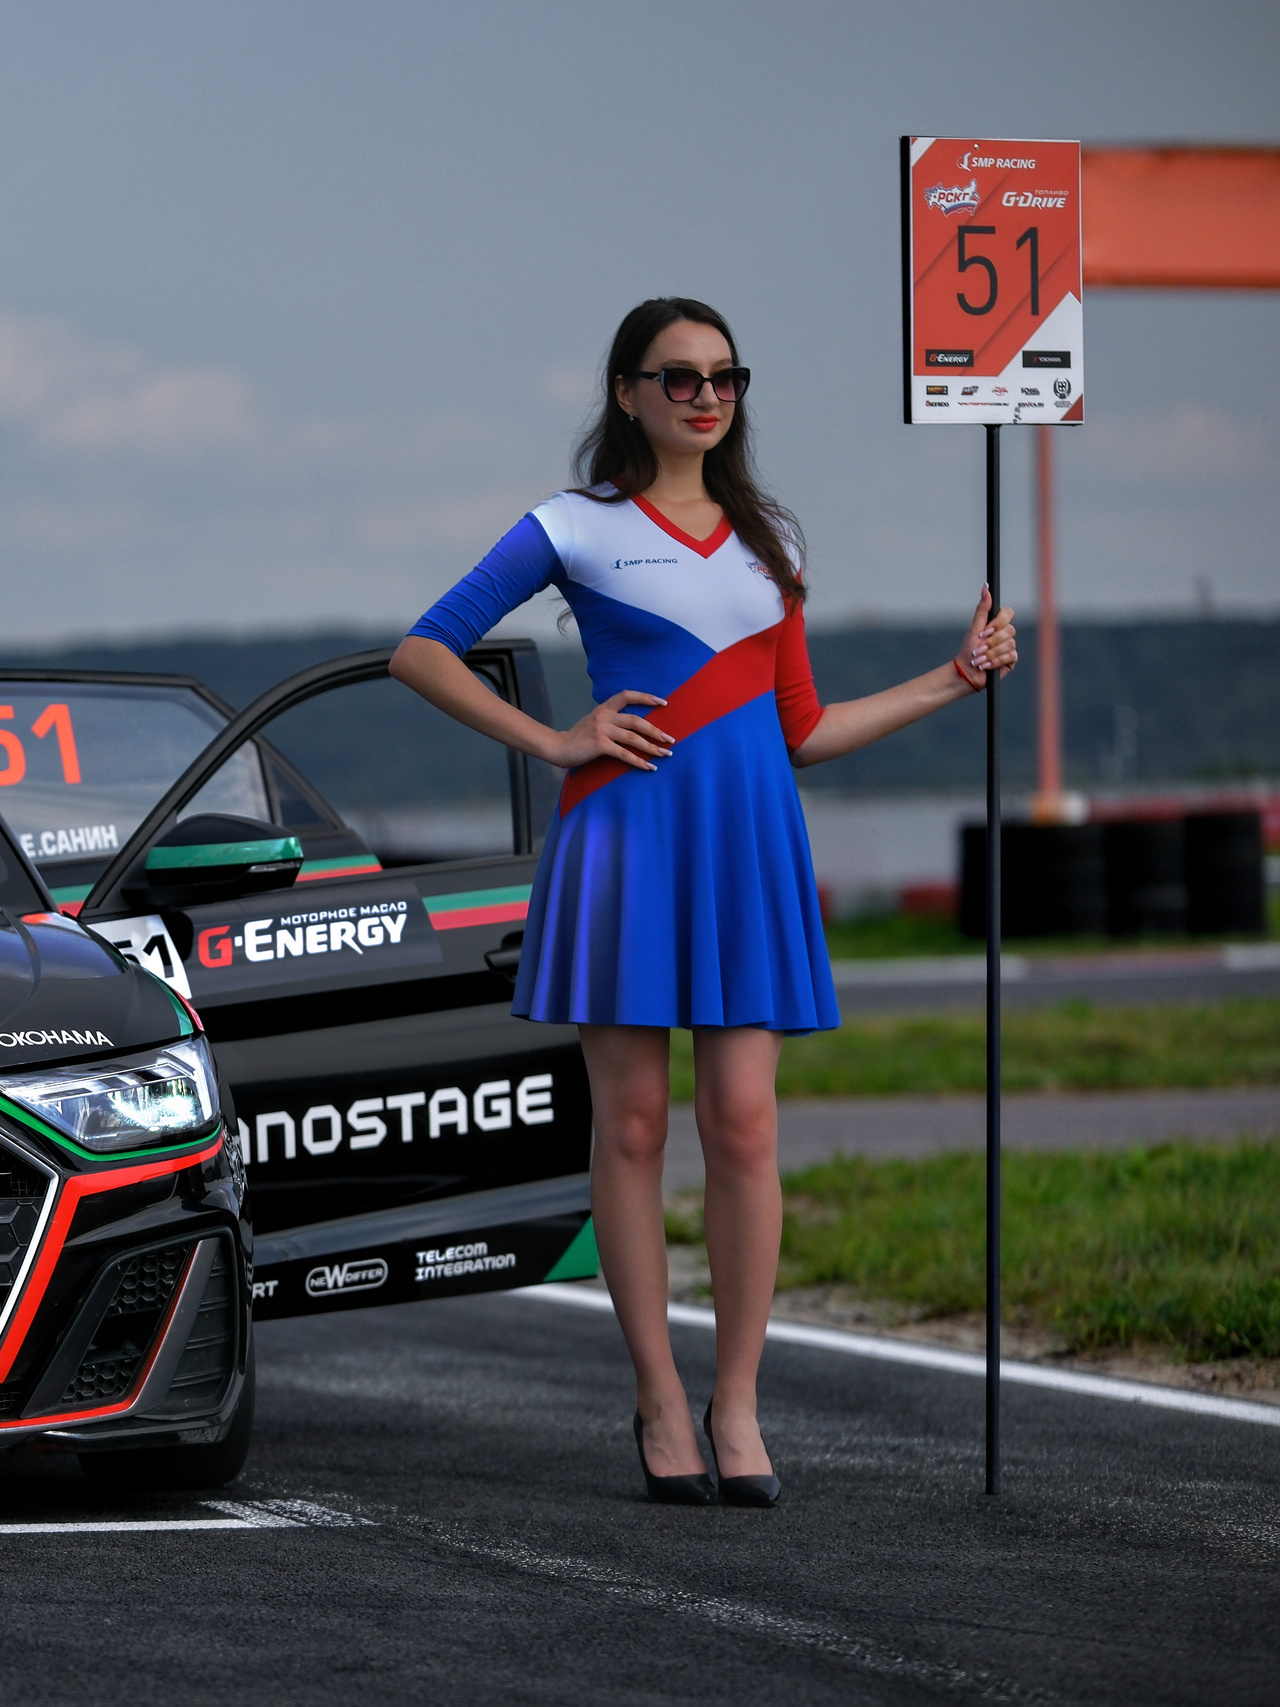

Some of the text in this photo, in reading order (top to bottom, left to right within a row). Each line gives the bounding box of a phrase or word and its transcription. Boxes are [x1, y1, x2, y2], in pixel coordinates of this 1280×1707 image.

[971, 157, 1036, 169] SMP RACING
[956, 225, 1040, 316] 51
[623, 559, 643, 567] SMP
[280, 901, 408, 926] МОТОРНОЕ МАСЛО
[416, 1241, 488, 1265] TELECOM
[414, 1253, 516, 1282] INTEGRATION
